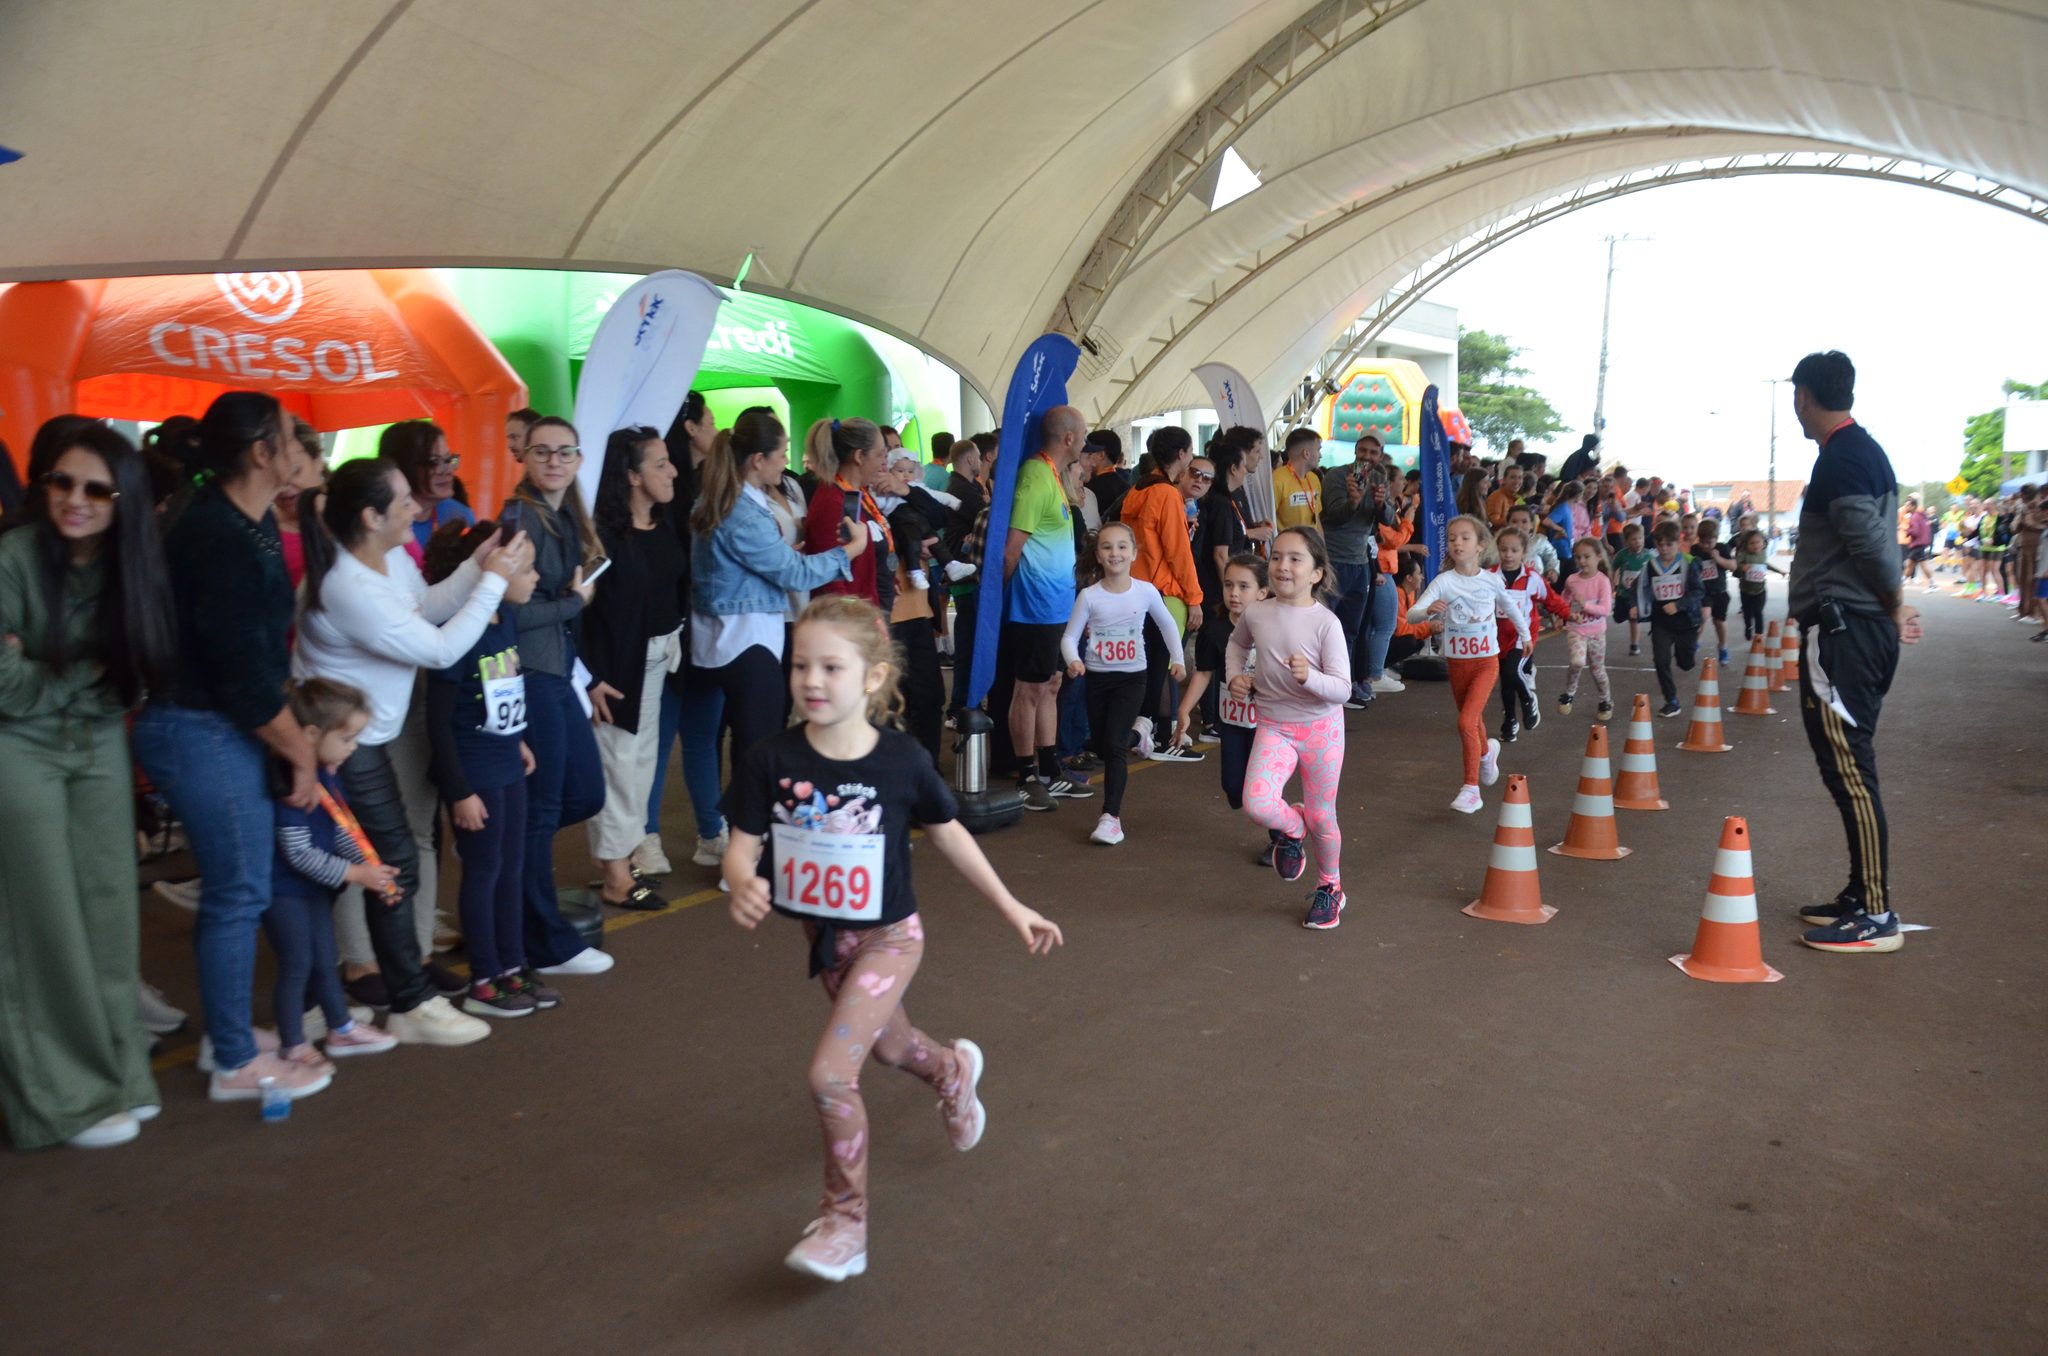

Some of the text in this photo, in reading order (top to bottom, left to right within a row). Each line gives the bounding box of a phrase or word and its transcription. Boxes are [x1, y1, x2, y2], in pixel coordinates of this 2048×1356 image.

[148, 321, 399, 382] CRESOL
[1095, 639, 1136, 661] 1366
[1449, 635, 1490, 656] 1364
[1222, 697, 1259, 724] 1270
[836, 782, 878, 800] Stitch
[783, 857, 871, 911] 1269
